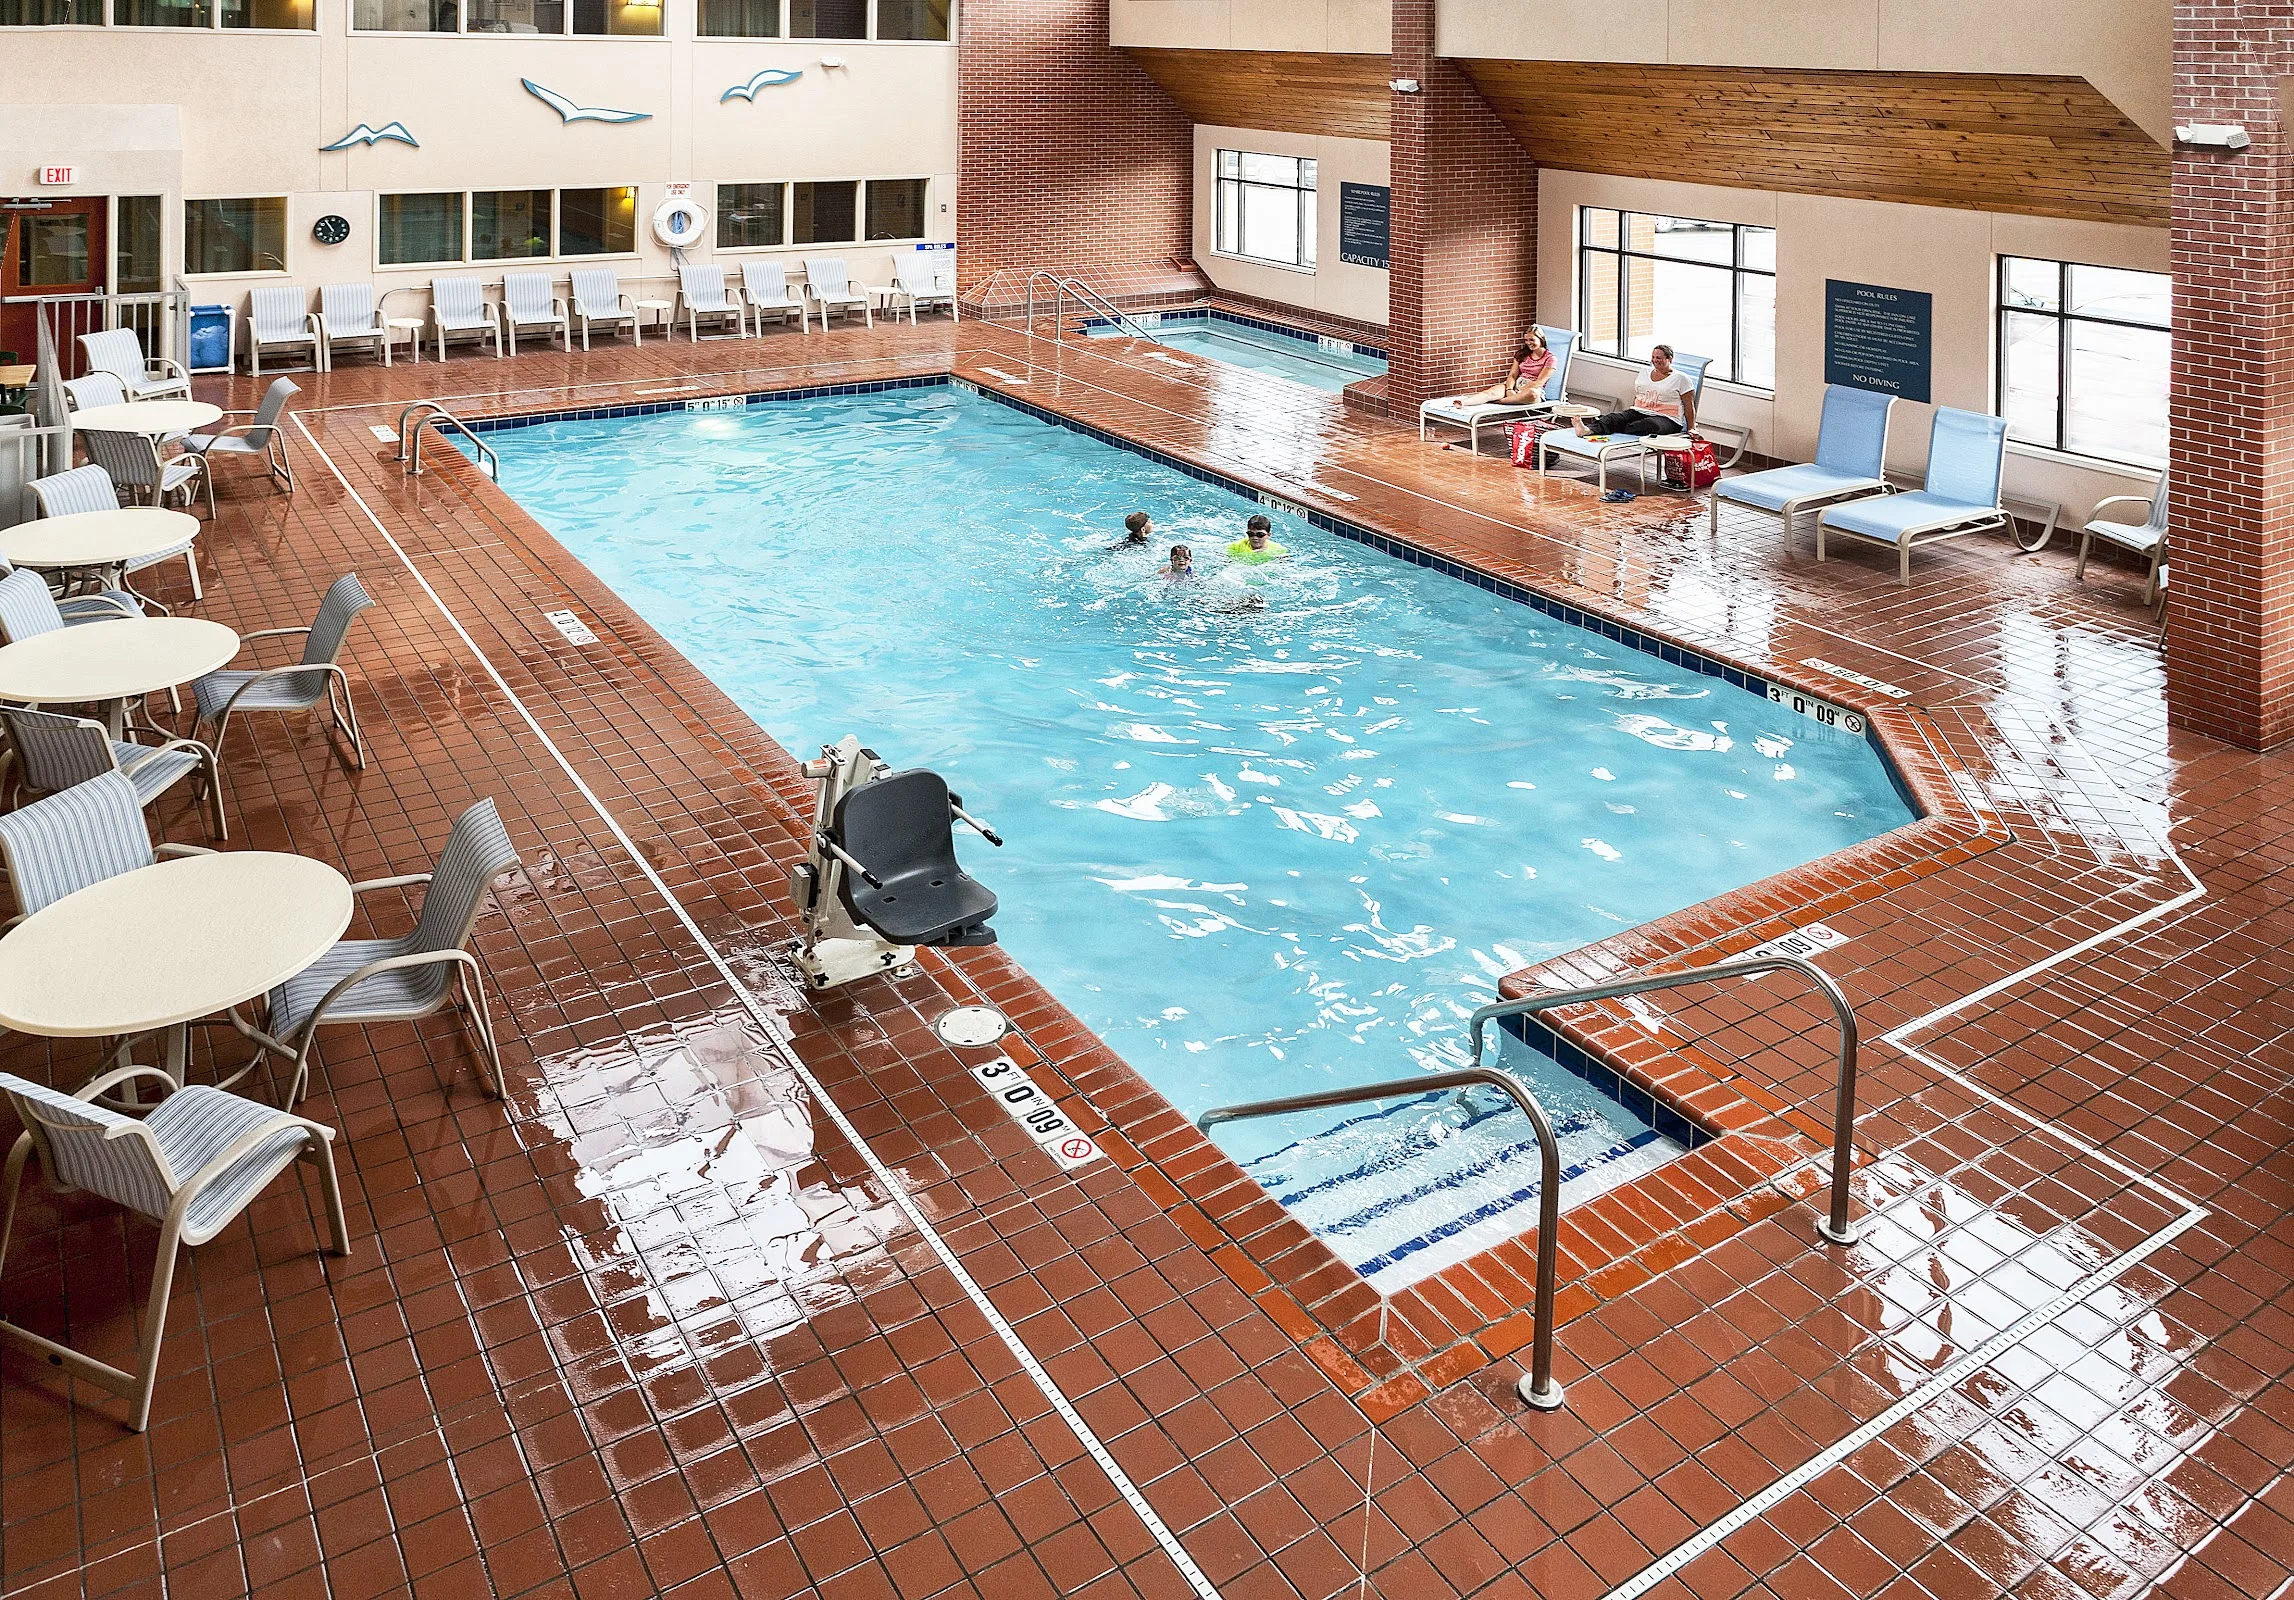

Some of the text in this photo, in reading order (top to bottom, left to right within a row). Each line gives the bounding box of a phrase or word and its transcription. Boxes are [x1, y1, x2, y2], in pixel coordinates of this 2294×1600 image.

[47, 168, 72, 182] EXIT
[1341, 252, 1380, 266] CAPACITY
[1856, 290, 1898, 301] POOL RULES
[1853, 374, 1899, 389] NO DIVING
[1770, 687, 1780, 703] 3
[1781, 690, 1789, 699] FT
[1794, 696, 1805, 714] 0
[1806, 700, 1814, 708] IN
[982, 1063, 1010, 1077] 3
[1005, 1086, 1034, 1103] 0
